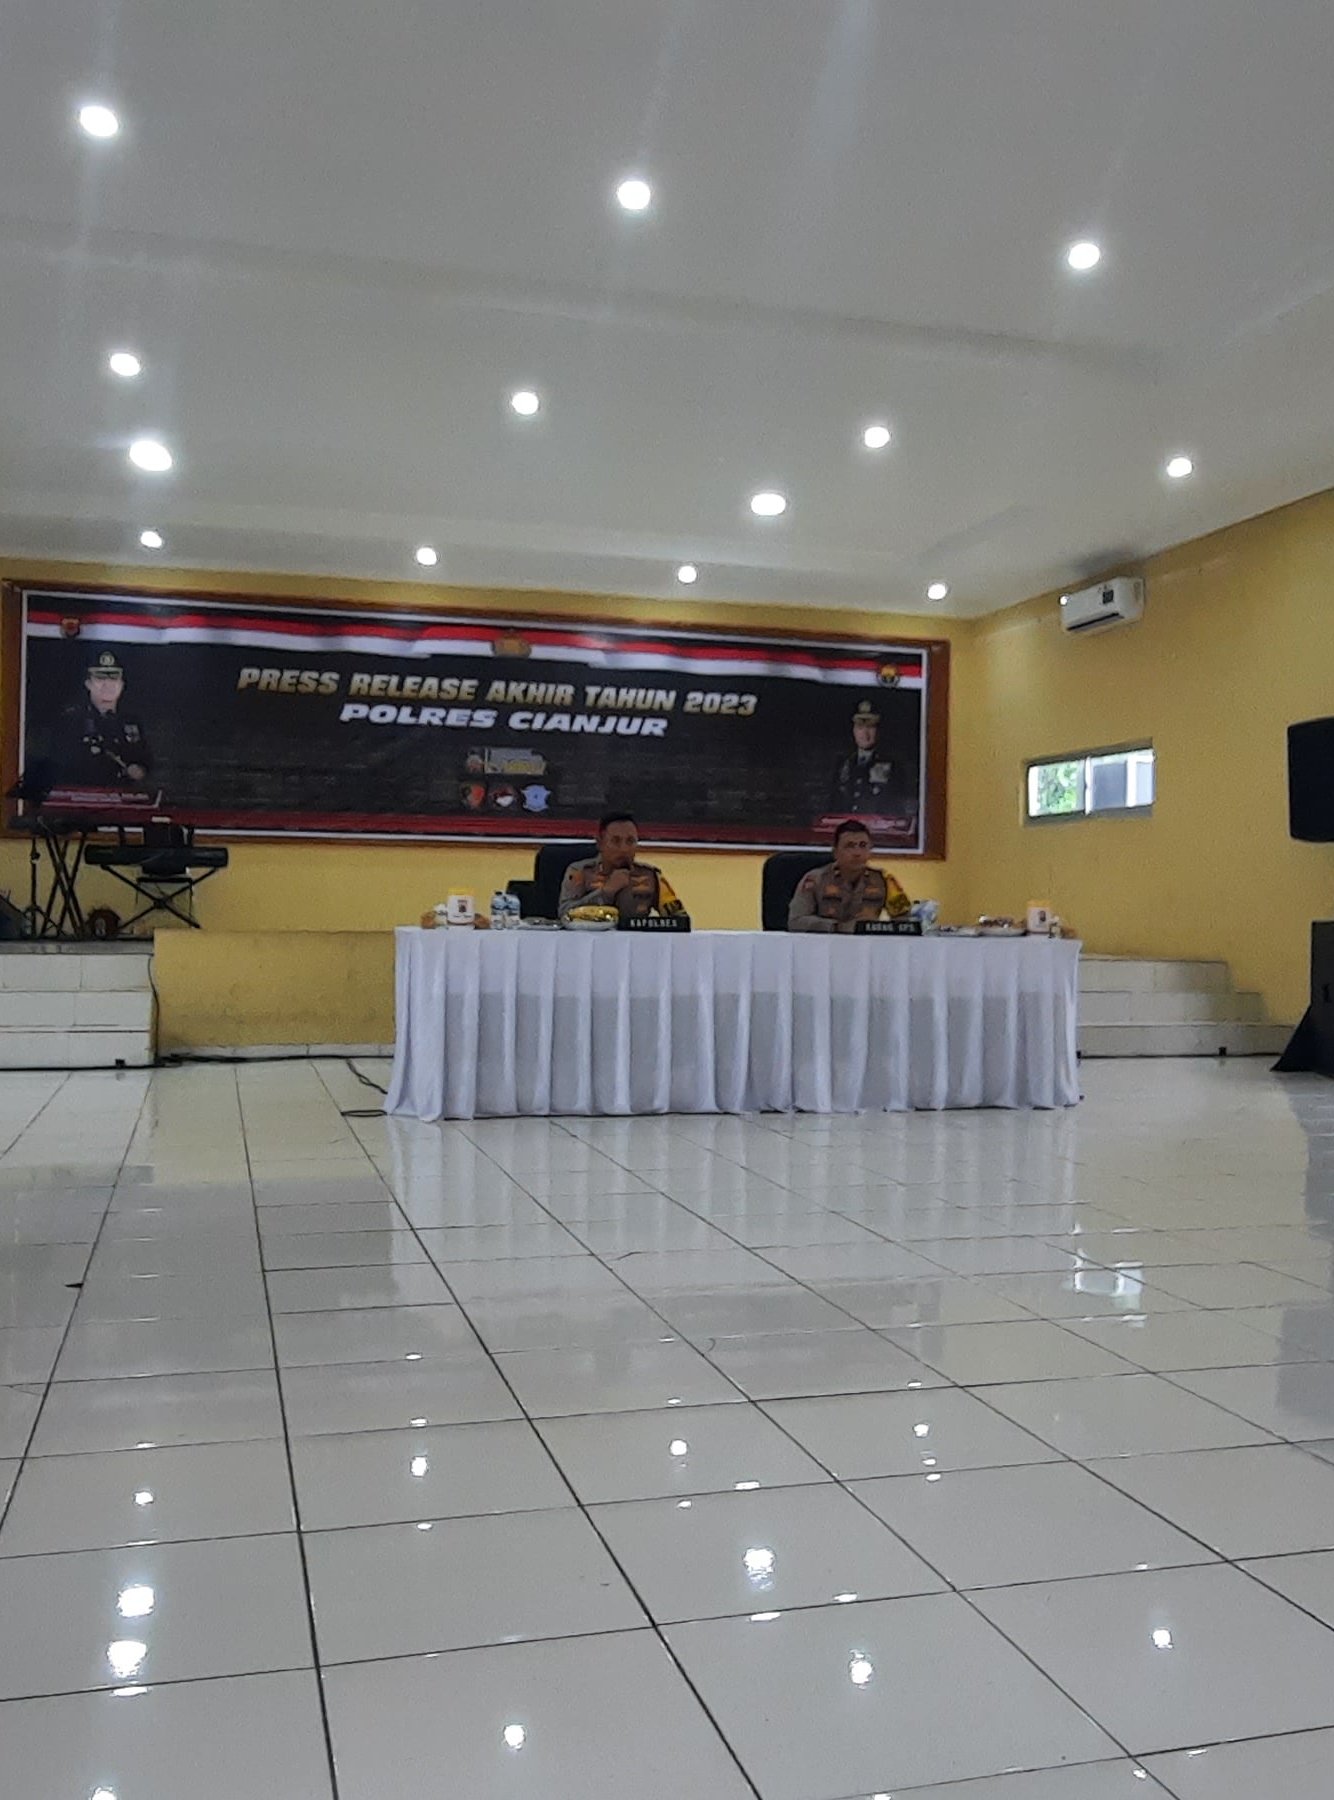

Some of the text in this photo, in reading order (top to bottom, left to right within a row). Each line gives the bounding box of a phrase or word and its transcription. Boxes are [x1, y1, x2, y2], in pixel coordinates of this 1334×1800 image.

[236, 667, 758, 716] PRESS RELEASE AKHIR TAHUN 2023
[339, 703, 669, 738] POLRES CIANJUR
